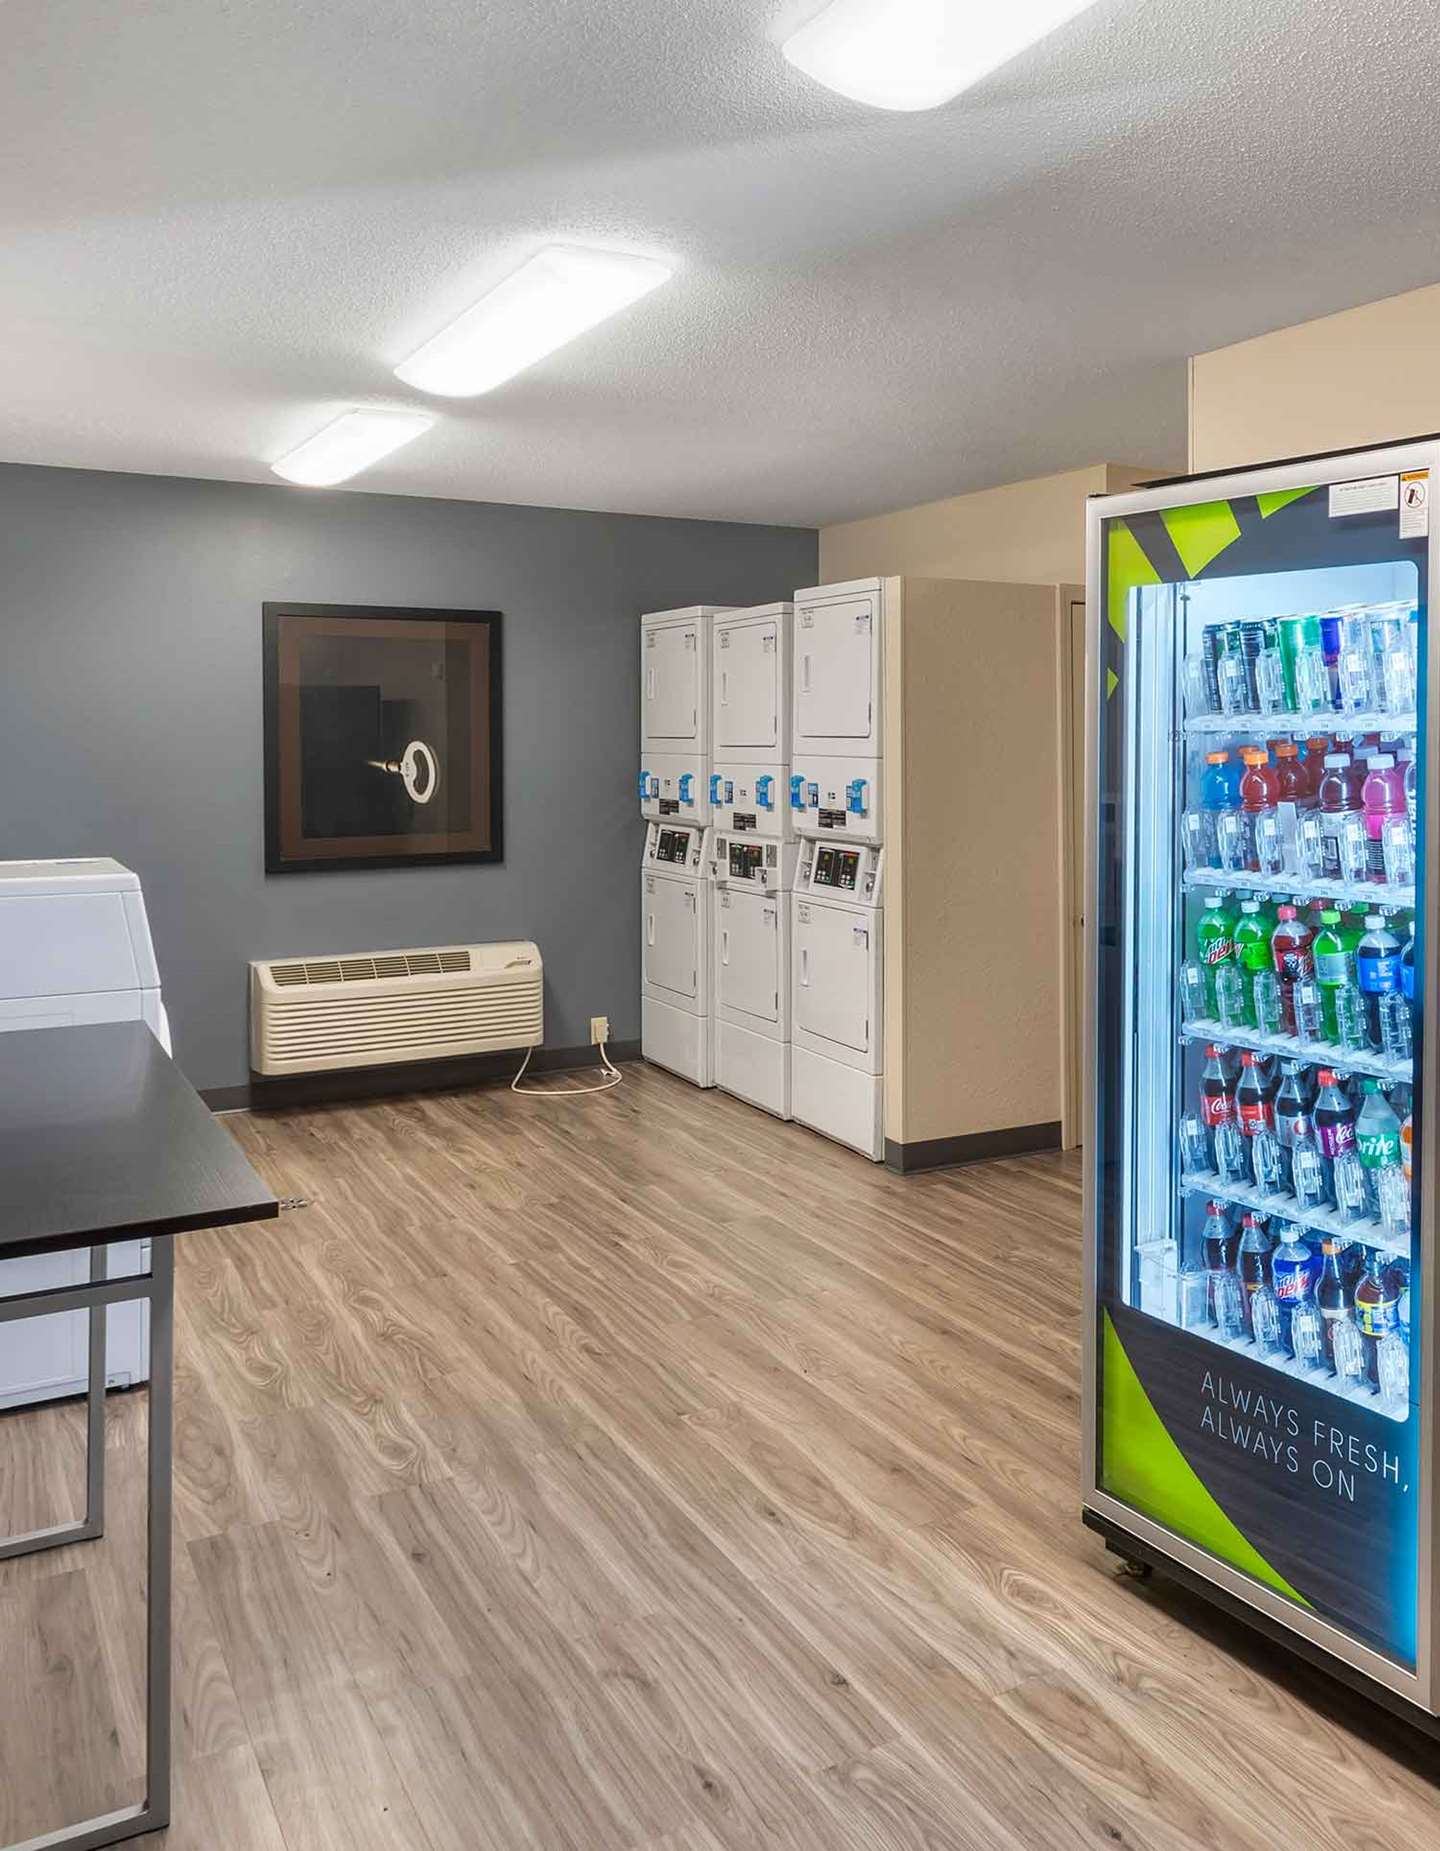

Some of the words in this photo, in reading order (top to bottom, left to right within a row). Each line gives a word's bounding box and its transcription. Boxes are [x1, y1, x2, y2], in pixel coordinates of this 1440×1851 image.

[1200, 1370, 1300, 1437] ALWAYS
[1313, 1419, 1409, 1493] FRESH,
[1200, 1405, 1299, 1474] ALWAYS
[1312, 1458, 1356, 1502] ON
